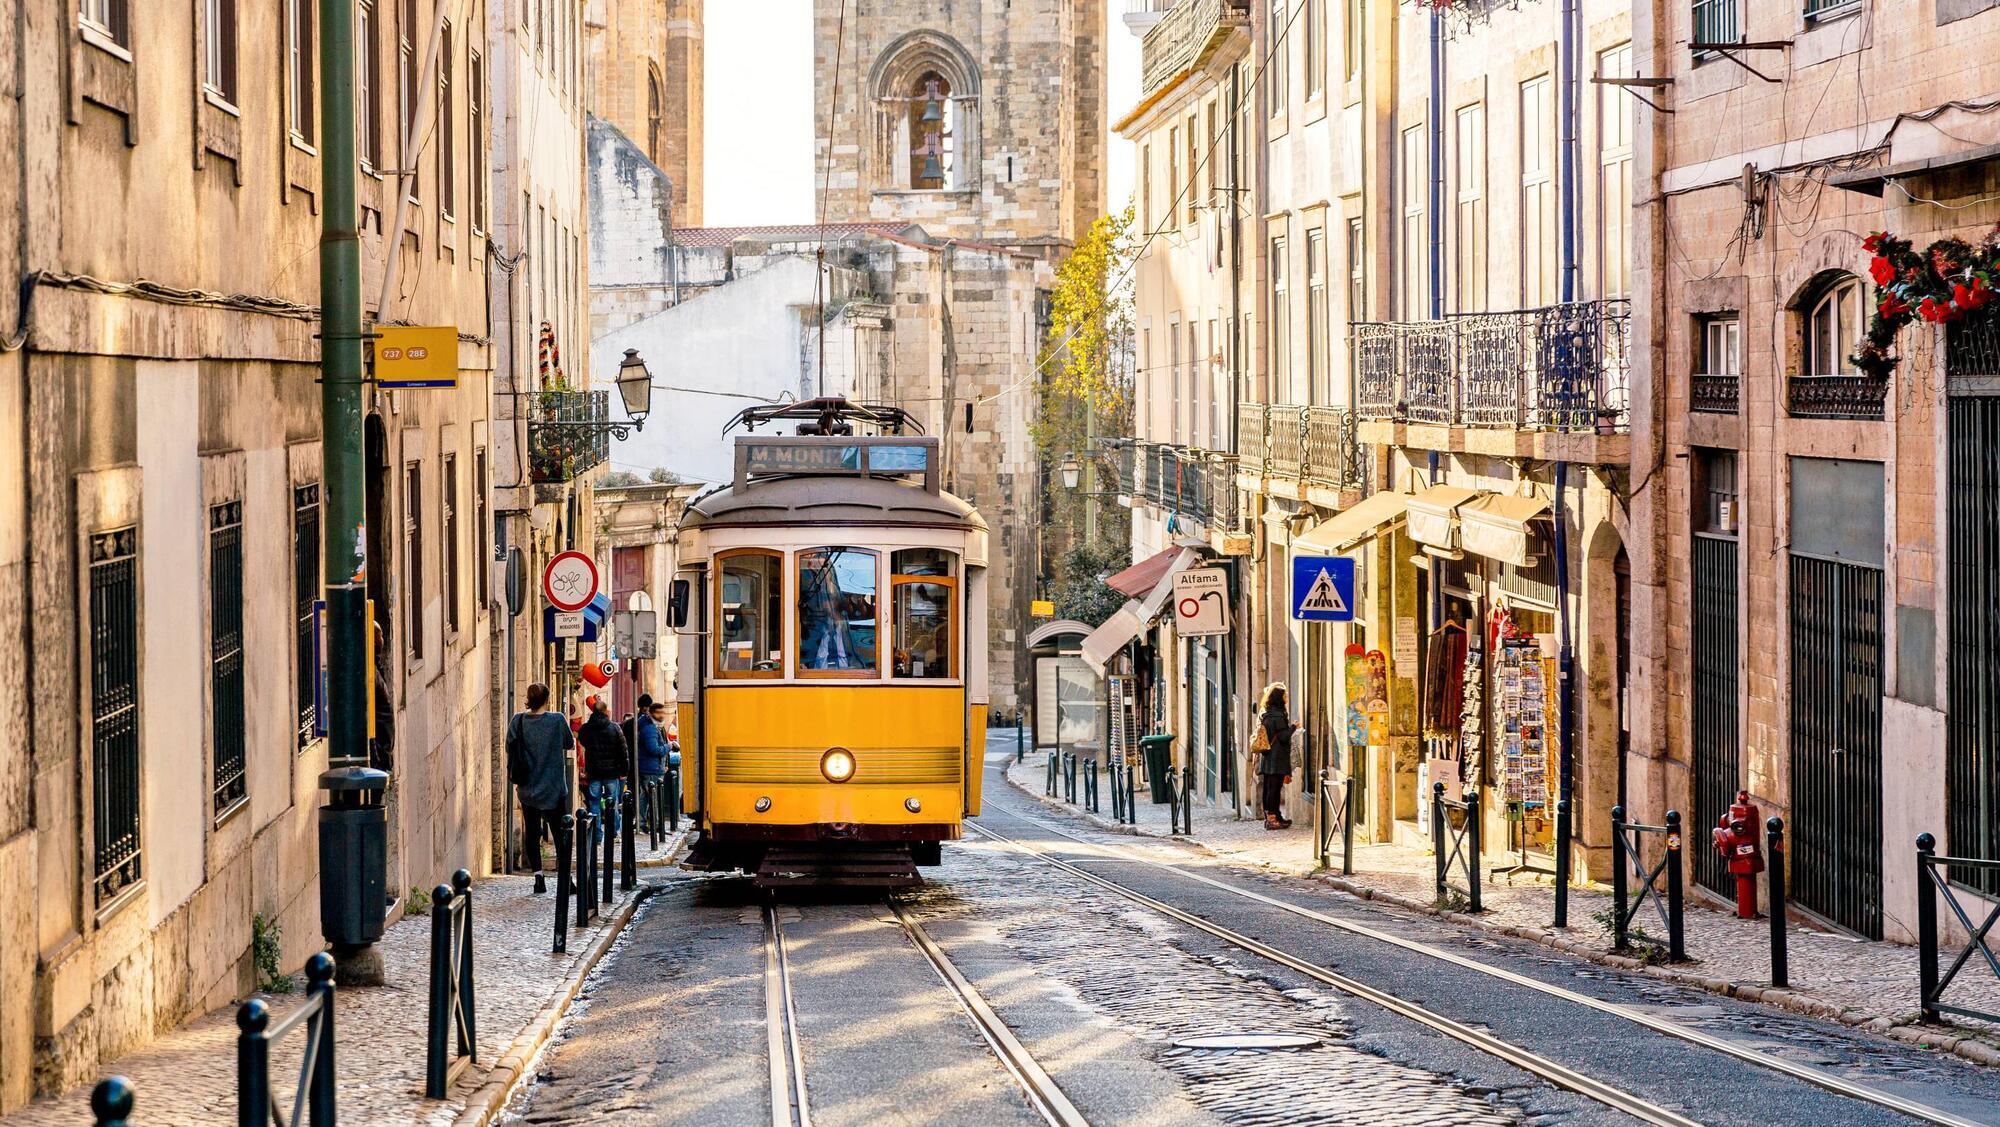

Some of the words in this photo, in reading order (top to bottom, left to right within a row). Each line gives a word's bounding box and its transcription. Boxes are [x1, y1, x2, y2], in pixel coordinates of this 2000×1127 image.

[384, 350, 401, 358] 737
[408, 349, 425, 358] 28E
[751, 447, 772, 461] M.
[877, 448, 908, 468] 28
[1181, 574, 1218, 584] Alfama
